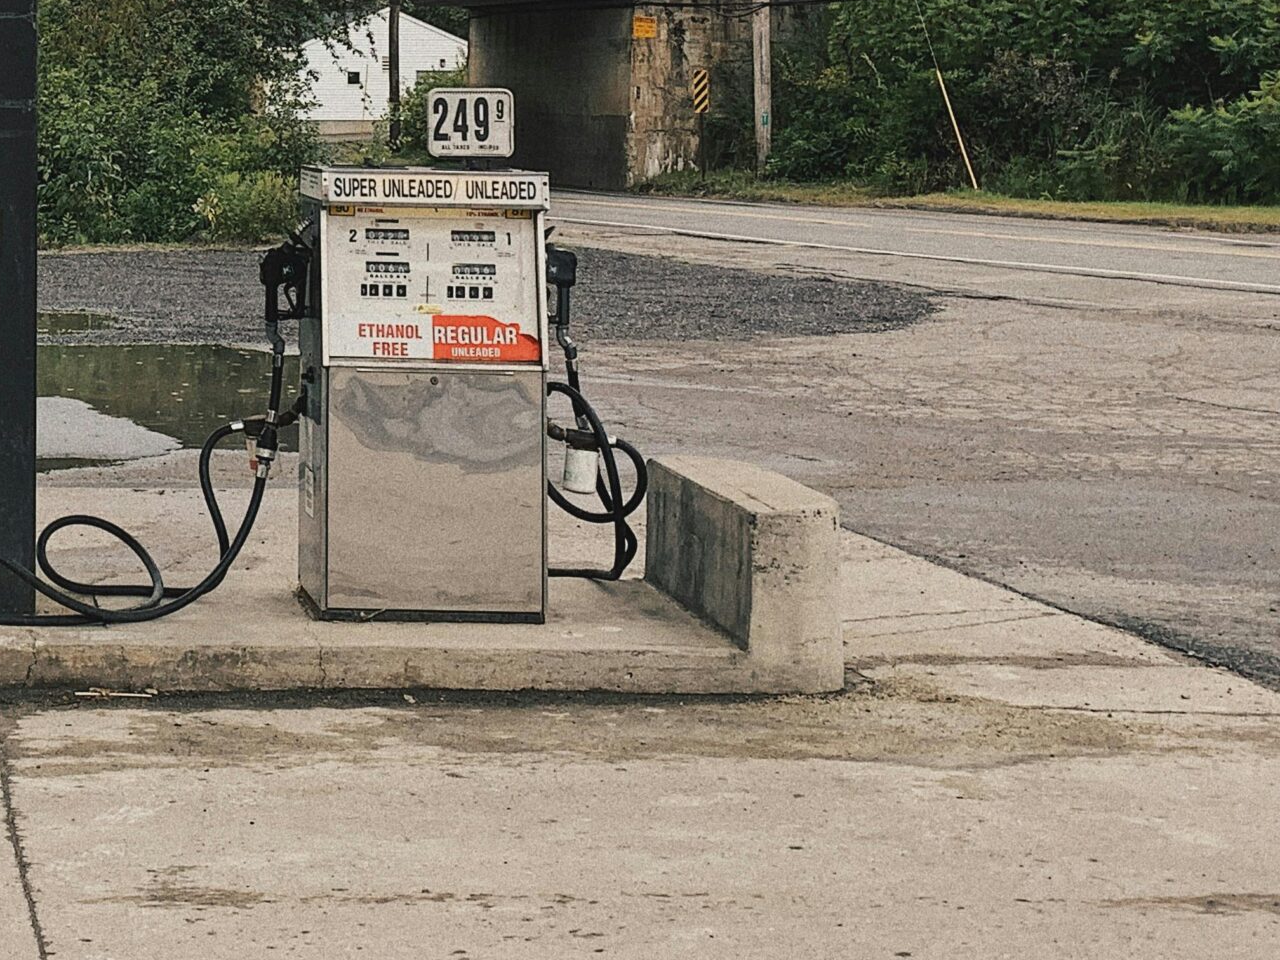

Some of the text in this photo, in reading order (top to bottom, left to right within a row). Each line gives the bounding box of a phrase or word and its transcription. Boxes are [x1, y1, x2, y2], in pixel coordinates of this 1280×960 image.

[496, 100, 504, 120] 9
[334, 178, 376, 198] SUPER
[382, 178, 452, 198] UNLEADED
[466, 181, 536, 200] UNLEADED
[349, 229, 357, 242] 2
[506, 232, 511, 246] 1
[358, 323, 422, 339] ETHANOL
[434, 326, 518, 345] REGULAR
[373, 342, 408, 356] FREE
[452, 347, 500, 358] UNLEADED
